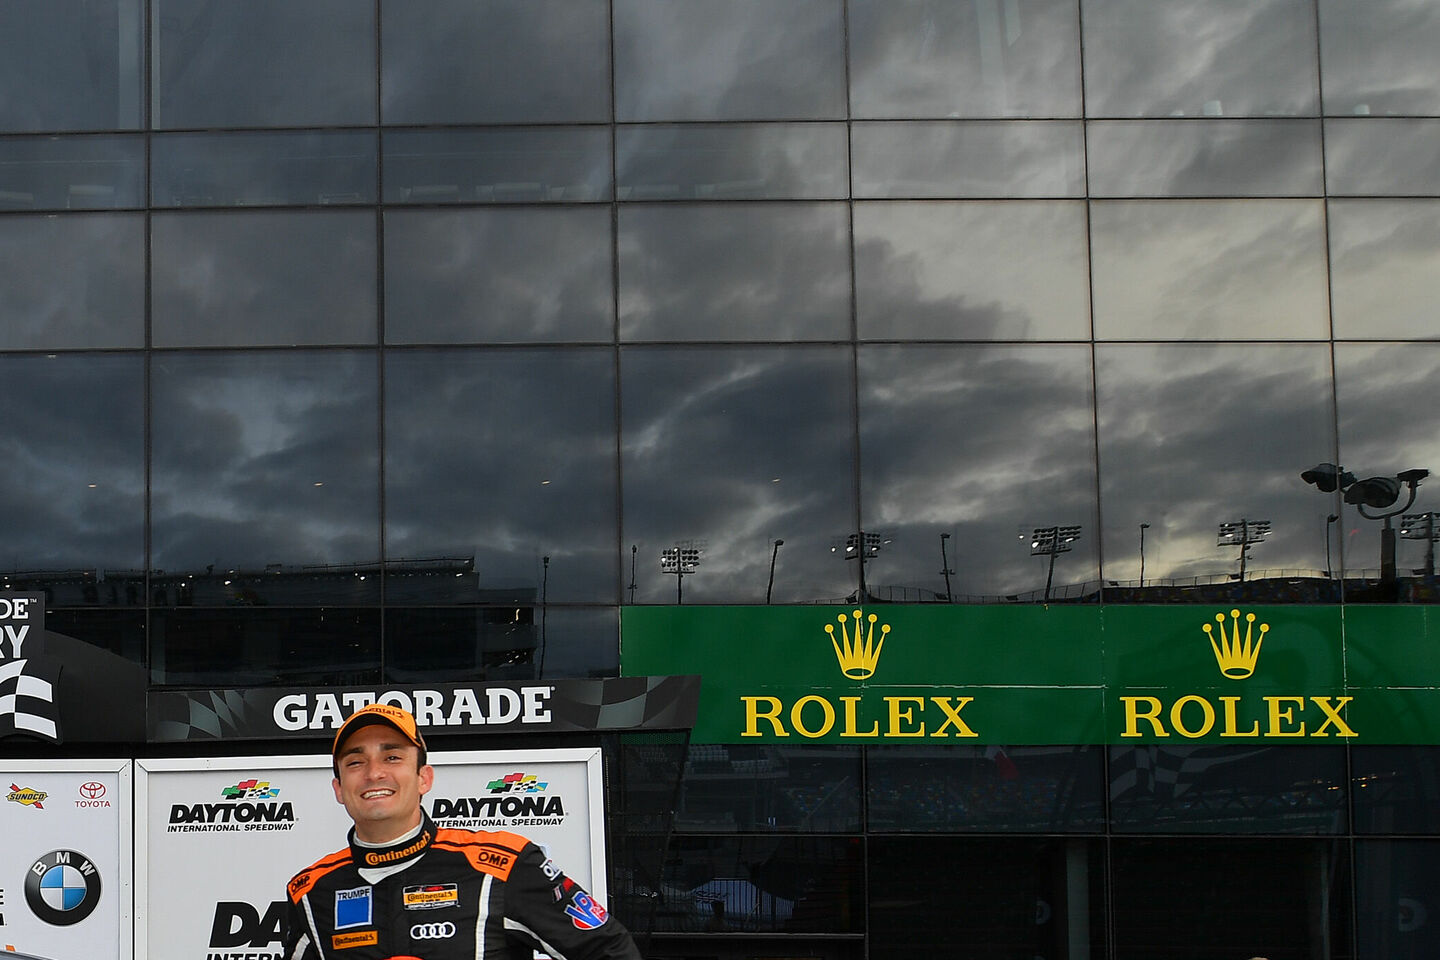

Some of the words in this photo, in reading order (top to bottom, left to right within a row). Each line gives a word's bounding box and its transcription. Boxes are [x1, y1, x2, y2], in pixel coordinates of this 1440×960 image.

[740, 695, 979, 738] ROLEX
[1120, 695, 1359, 738] ROLEX
[9, 792, 45, 802] SUNOCO
[75, 800, 111, 808] TOYOTA
[169, 803, 294, 823] DAYTONA
[432, 797, 564, 819] DAYTONA
[244, 823, 294, 831] SPEEDWAY
[433, 819, 508, 827] NTERNATIONAL
[511, 818, 564, 826] SPEEDWAY
[365, 832, 428, 865] Continental
[478, 852, 509, 867] OMP
[338, 889, 370, 900] TRUMPF
